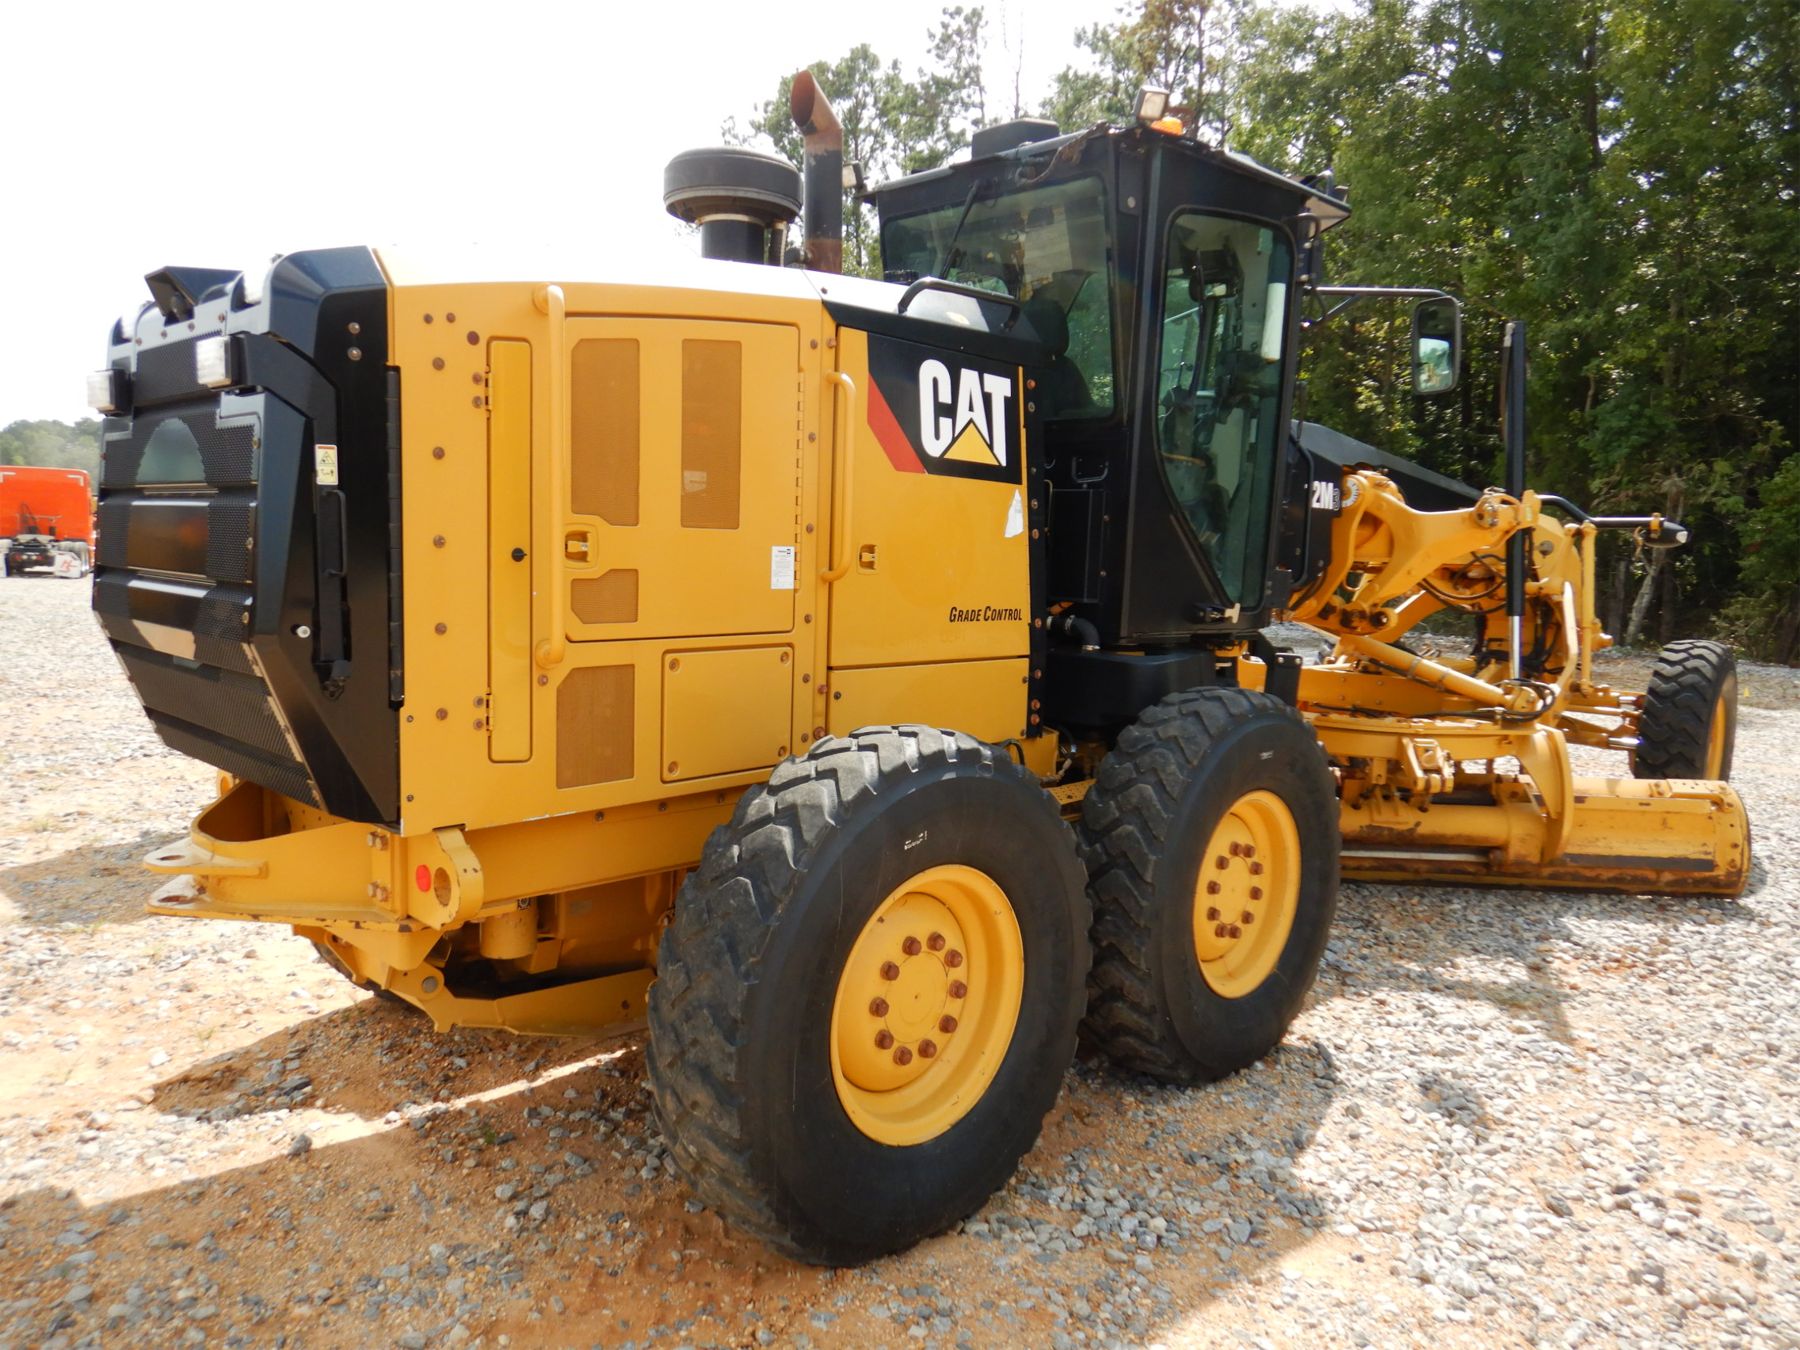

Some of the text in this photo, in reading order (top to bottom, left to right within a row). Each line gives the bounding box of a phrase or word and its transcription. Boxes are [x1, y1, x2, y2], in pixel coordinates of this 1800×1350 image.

[919, 359, 1011, 467] CAT
[1304, 480, 1334, 510] 2M
[949, 606, 1023, 622] GRADE CONTROL
